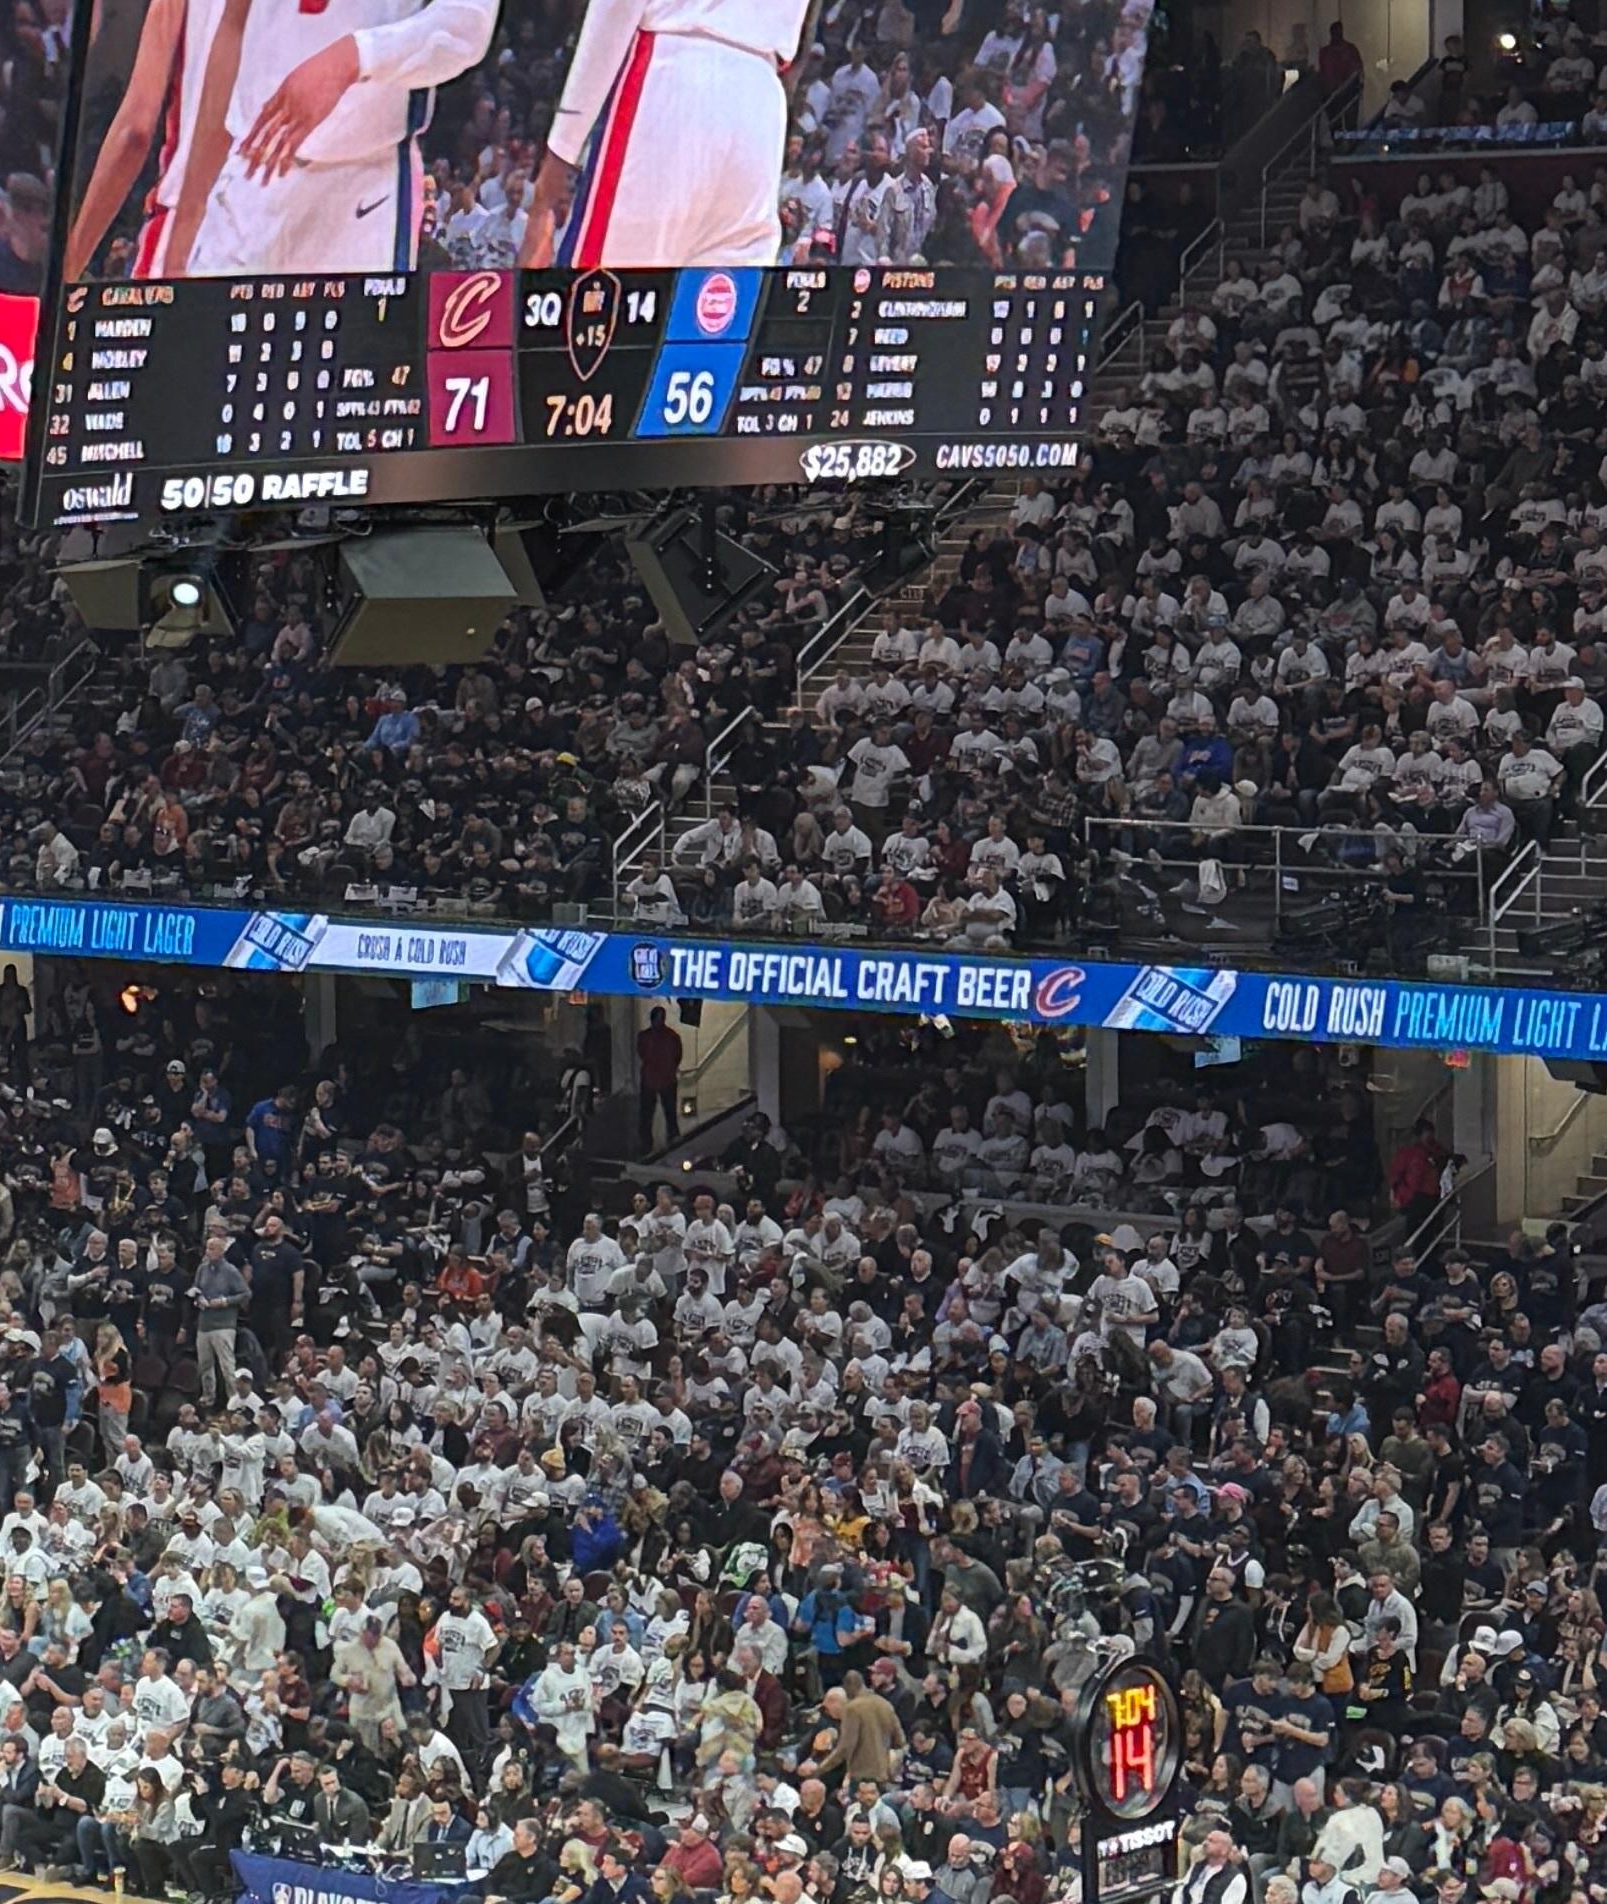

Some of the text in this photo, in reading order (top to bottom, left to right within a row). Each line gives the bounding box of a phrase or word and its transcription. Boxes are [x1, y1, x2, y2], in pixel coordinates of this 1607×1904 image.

[524, 290, 657, 327] 3Q 14
[445, 375, 490, 432] 71
[545, 394, 613, 437] 7:04
[663, 371, 716, 425] 56
[830, 409, 850, 428] 24
[45, 445, 68, 467] 45
[62, 473, 134, 513] oswald
[261, 469, 370, 502] RAFFLE
[802, 443, 902, 483] $25,882
[935, 441, 1079, 469] CAVS5050.COM
[8, 904, 85, 949] PREMIUM
[91, 910, 136, 954] LIGHT
[143, 912, 196, 956] LAGER
[357, 933, 467, 966] CRUSH A COLD RUSH
[669, 947, 723, 990] THE
[728, 951, 848, 999] OFFICIAL
[856, 958, 951, 1004] CRAFT
[957, 965, 1032, 1010] BEER
[1262, 980, 1317, 1034] COLD
[1327, 983, 1385, 1038] RUSH
[1394, 989, 1504, 1046] PREMIUM
[1511, 996, 1582, 1050] LIGHT
[1106, 1683, 1157, 1731] 7:04
[1113, 1724, 1154, 1800] 14
[1119, 1820, 1176, 1853] TISSOT
